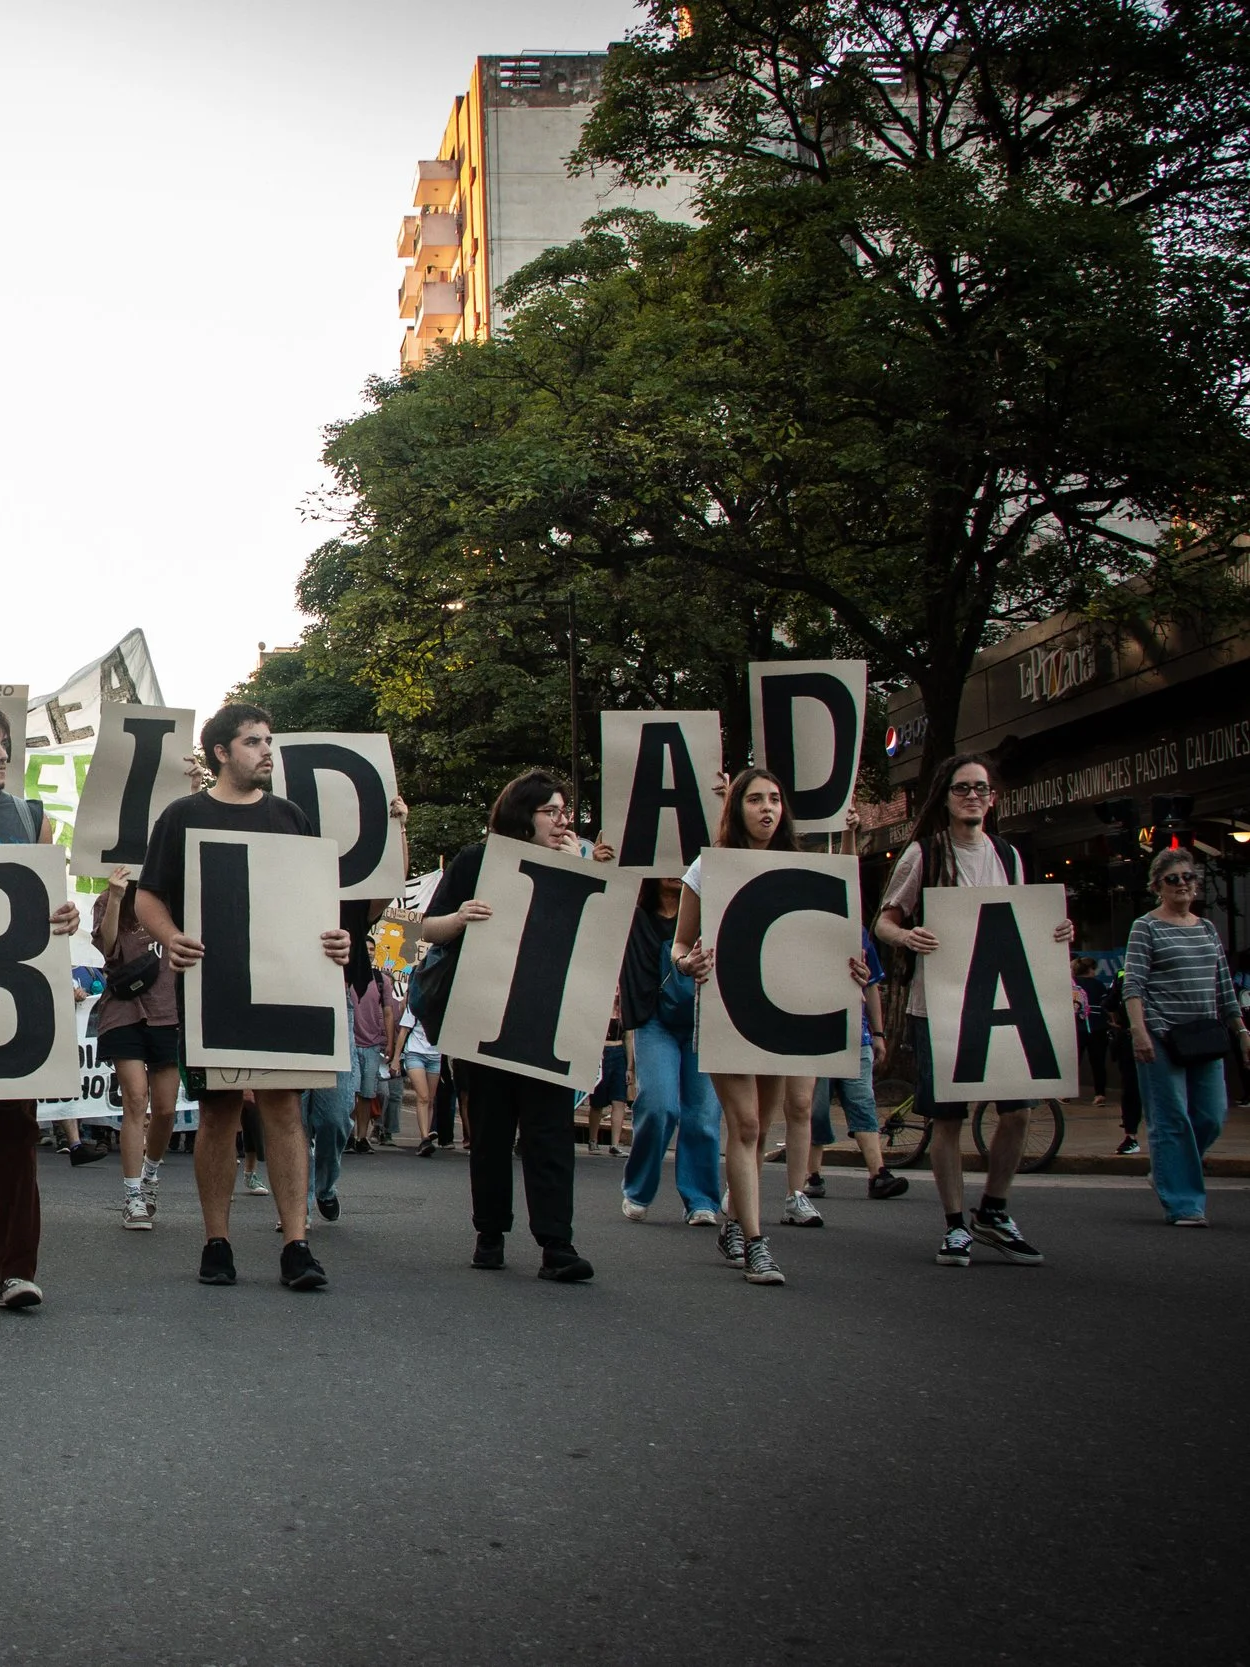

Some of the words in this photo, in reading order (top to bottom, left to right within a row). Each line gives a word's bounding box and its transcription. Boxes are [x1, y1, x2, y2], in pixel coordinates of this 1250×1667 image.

[101, 718, 175, 864] I
[282, 744, 389, 886] D
[618, 722, 710, 867] A
[761, 673, 857, 820] D
[1011, 776, 1063, 816] EMPANADAS
[1067, 755, 1131, 803] SANDWICHES
[1136, 741, 1178, 784] PASTAS
[1186, 720, 1250, 770] CALZONES
[199, 841, 335, 1056] L
[477, 859, 606, 1075] I
[716, 868, 848, 1056] C
[953, 902, 1061, 1084] A
